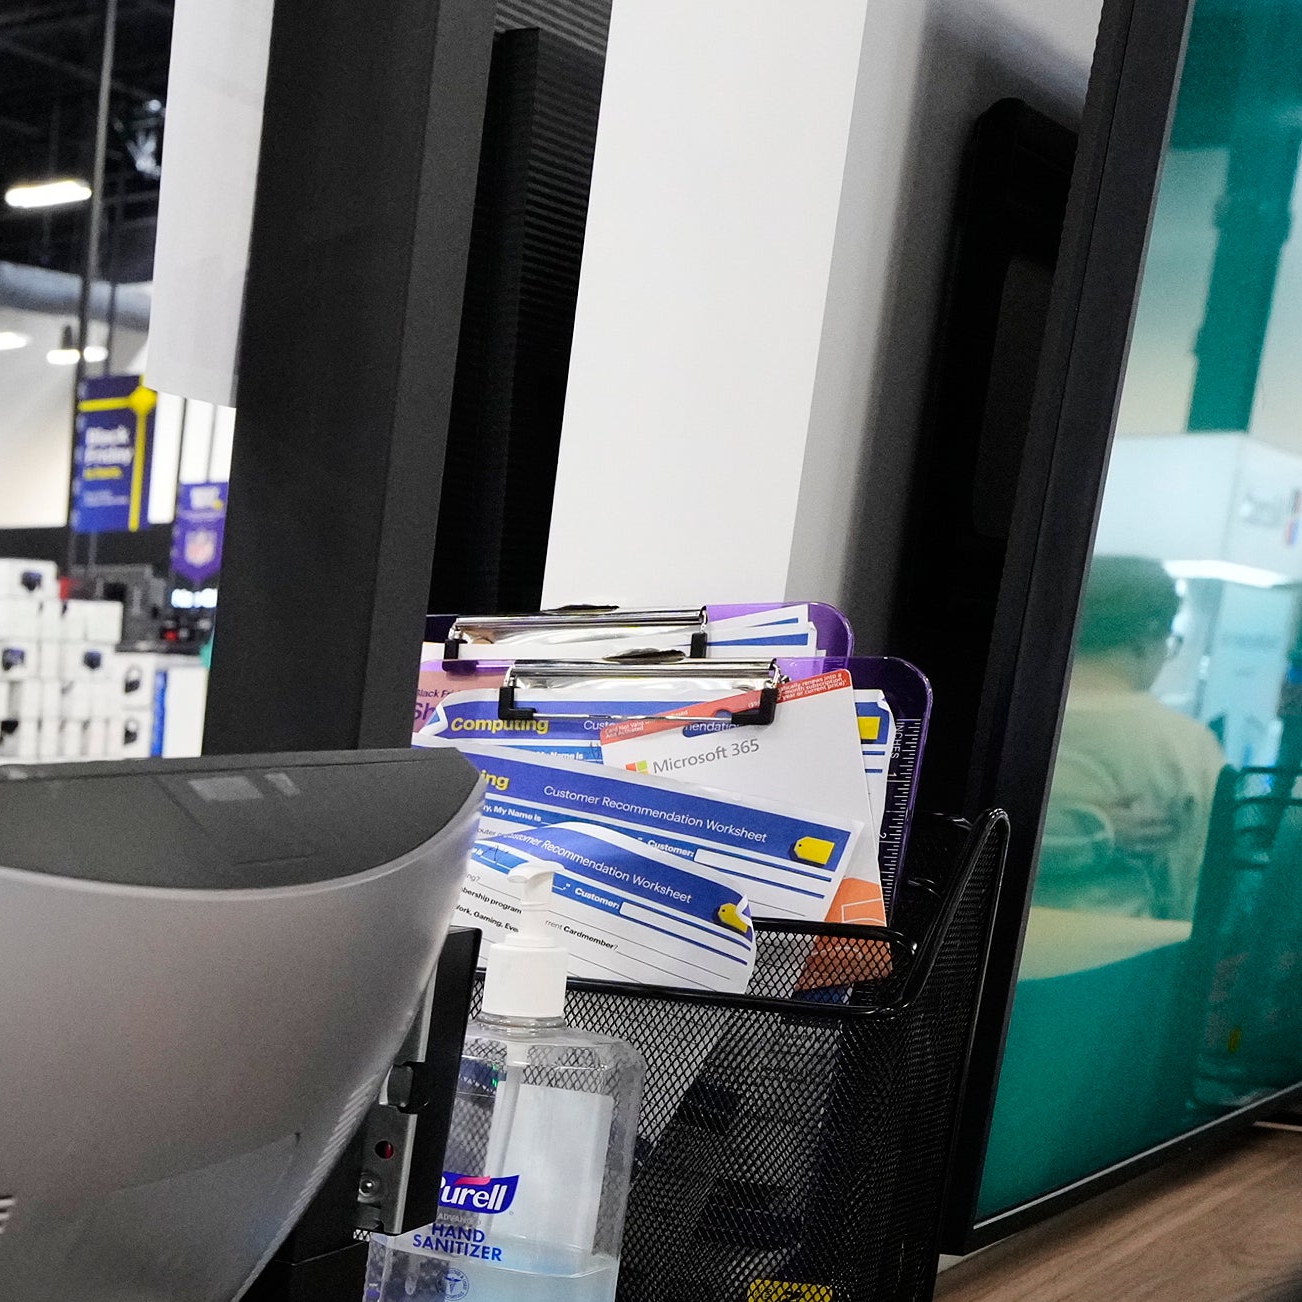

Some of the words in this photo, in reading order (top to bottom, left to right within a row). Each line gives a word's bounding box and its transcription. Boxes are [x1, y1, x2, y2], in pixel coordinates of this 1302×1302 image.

[451, 717, 549, 734] Computing
[890, 722, 905, 760] INCHES
[653, 747, 727, 773] Microsoft
[732, 738, 760, 758] 365
[494, 806, 507, 815] My
[508, 809, 532, 820] Name
[544, 785, 600, 804] Customer
[601, 796, 703, 828] Recommendation
[706, 819, 768, 844] Worksheet
[543, 840, 630, 881] Recommendation
[633, 874, 693, 904] Worksheet
[462, 887, 489, 903] bership
[574, 887, 620, 910] Customer:
[545, 920, 563, 930] rrent
[431, 1222, 486, 1243] HAND
[413, 1234, 502, 1261] SANITIZER
